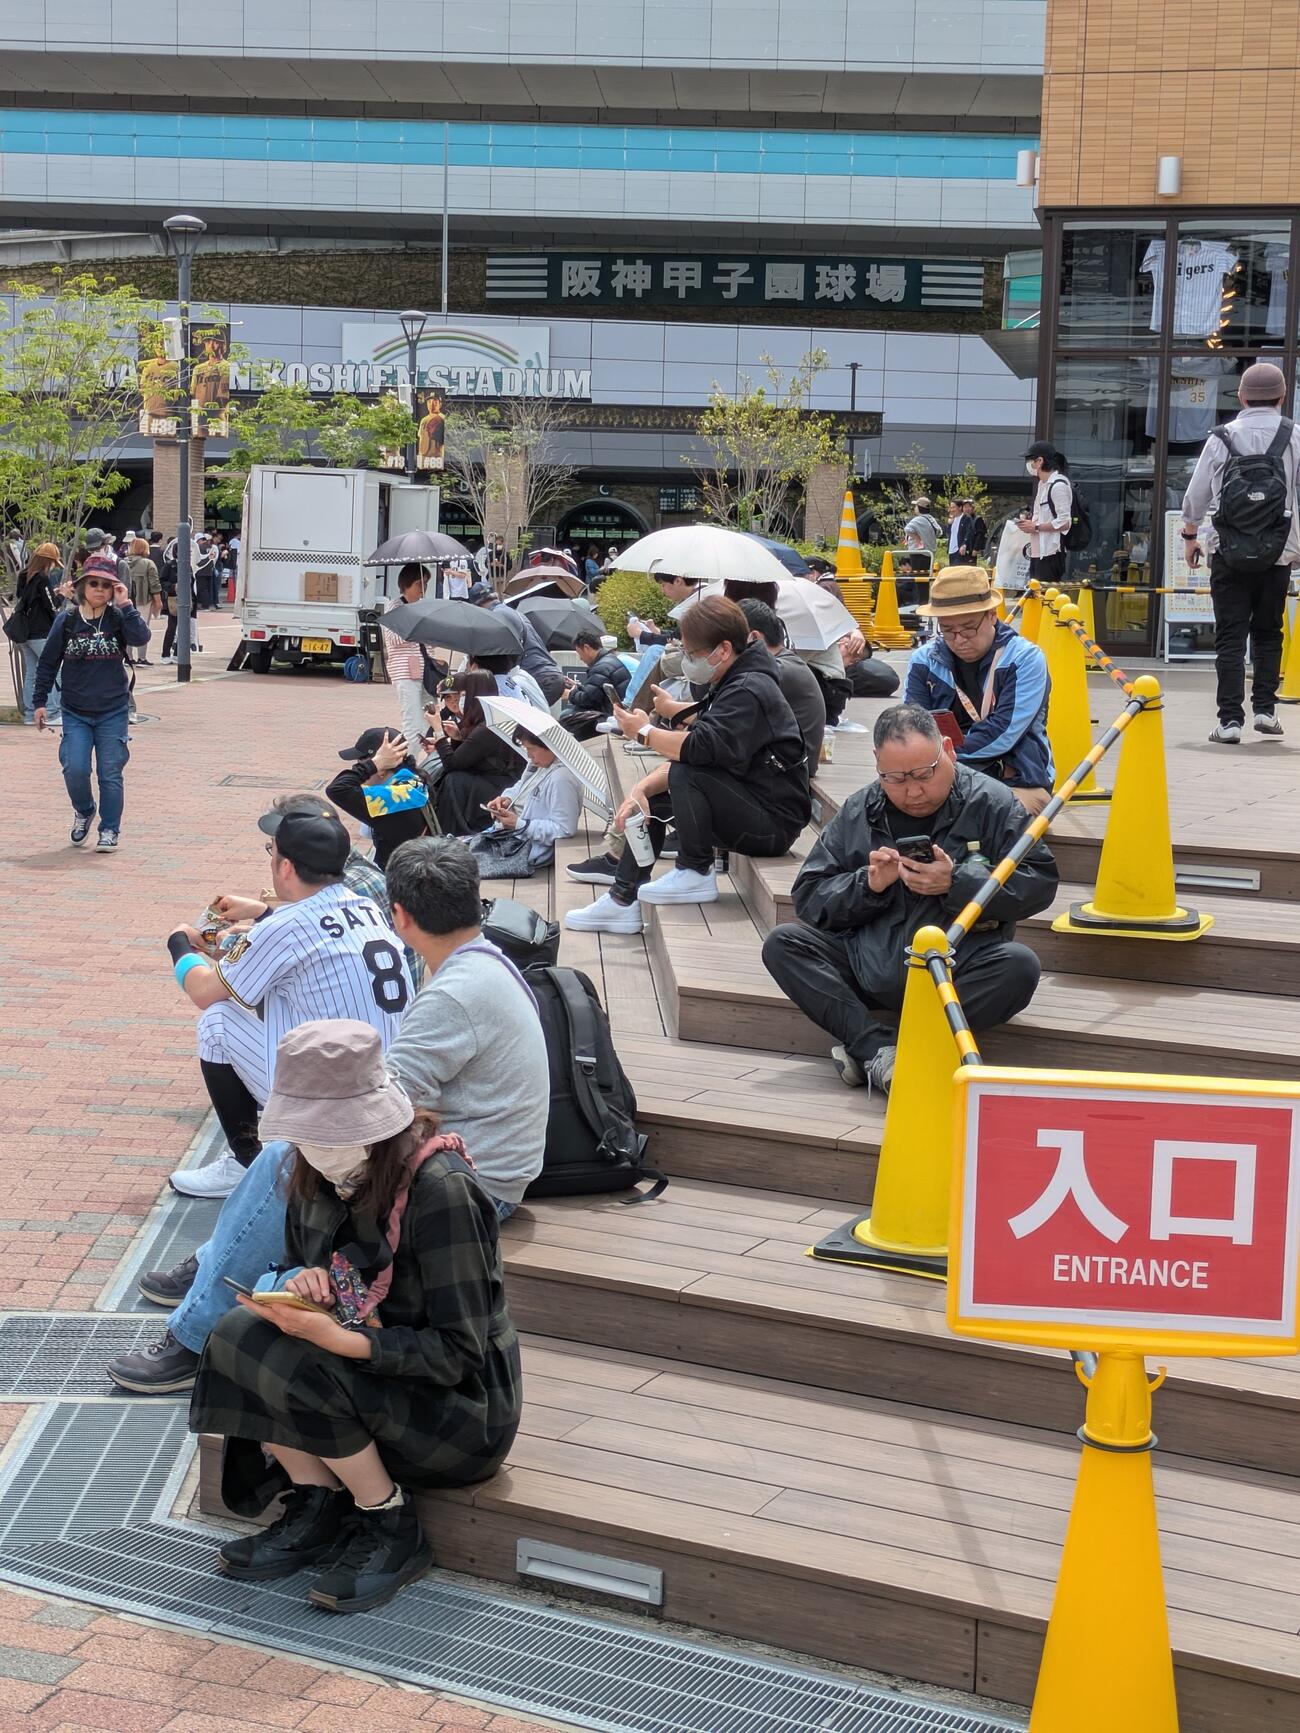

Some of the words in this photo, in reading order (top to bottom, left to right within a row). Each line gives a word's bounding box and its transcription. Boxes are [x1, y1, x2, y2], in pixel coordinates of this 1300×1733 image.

[560, 259, 908, 303] 阪神甲子園球場
[1176, 262, 1215, 280] igers
[261, 361, 421, 395] KOSHIEN
[428, 364, 593, 399] STADIUM
[1190, 391, 1206, 403] 35
[599, 484, 610, 496] C
[362, 939, 408, 1014] 8
[1007, 1128, 1257, 1246] 入口
[1053, 1254, 1209, 1289] ENTRANCE
